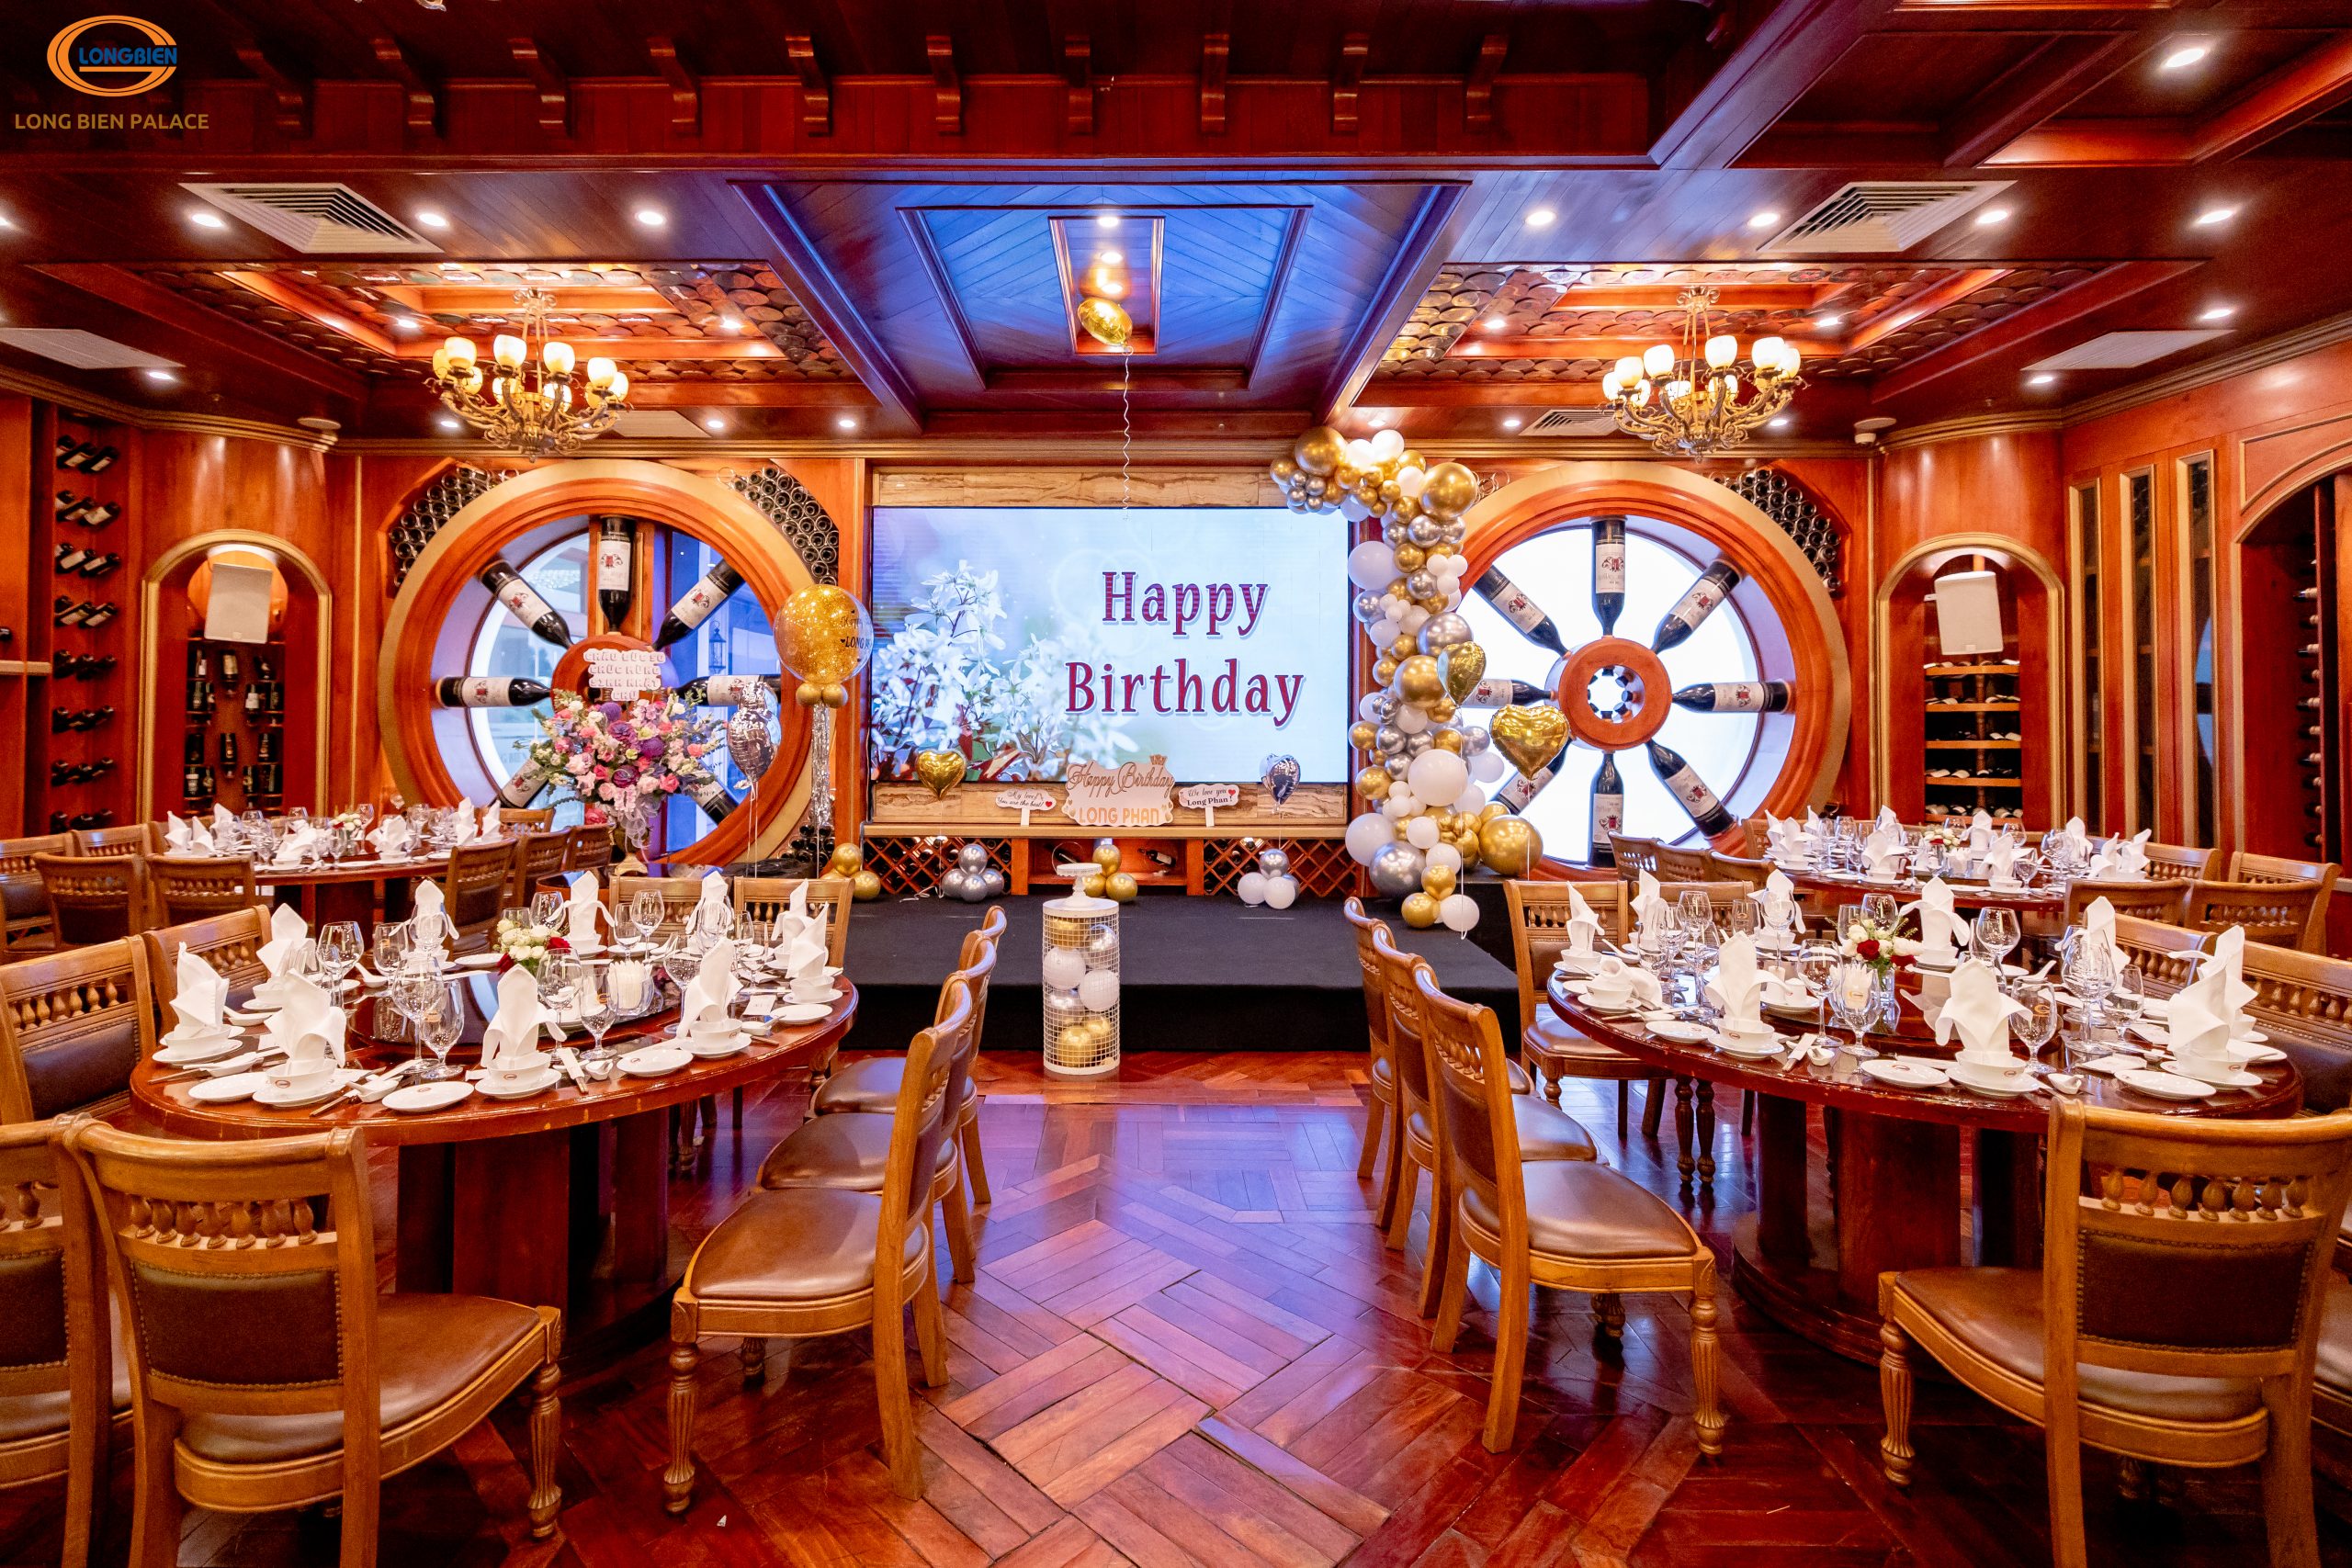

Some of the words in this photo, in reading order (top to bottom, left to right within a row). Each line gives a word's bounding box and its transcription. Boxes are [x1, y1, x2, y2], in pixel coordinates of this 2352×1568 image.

[1102, 570, 1270, 637] Happy
[1064, 657, 1306, 728] Birthday
[1067, 761, 1117, 797] Happy
[1116, 761, 1175, 798] Birthday
[1079, 807, 1118, 824] LONG
[1123, 807, 1159, 825] PHAN
